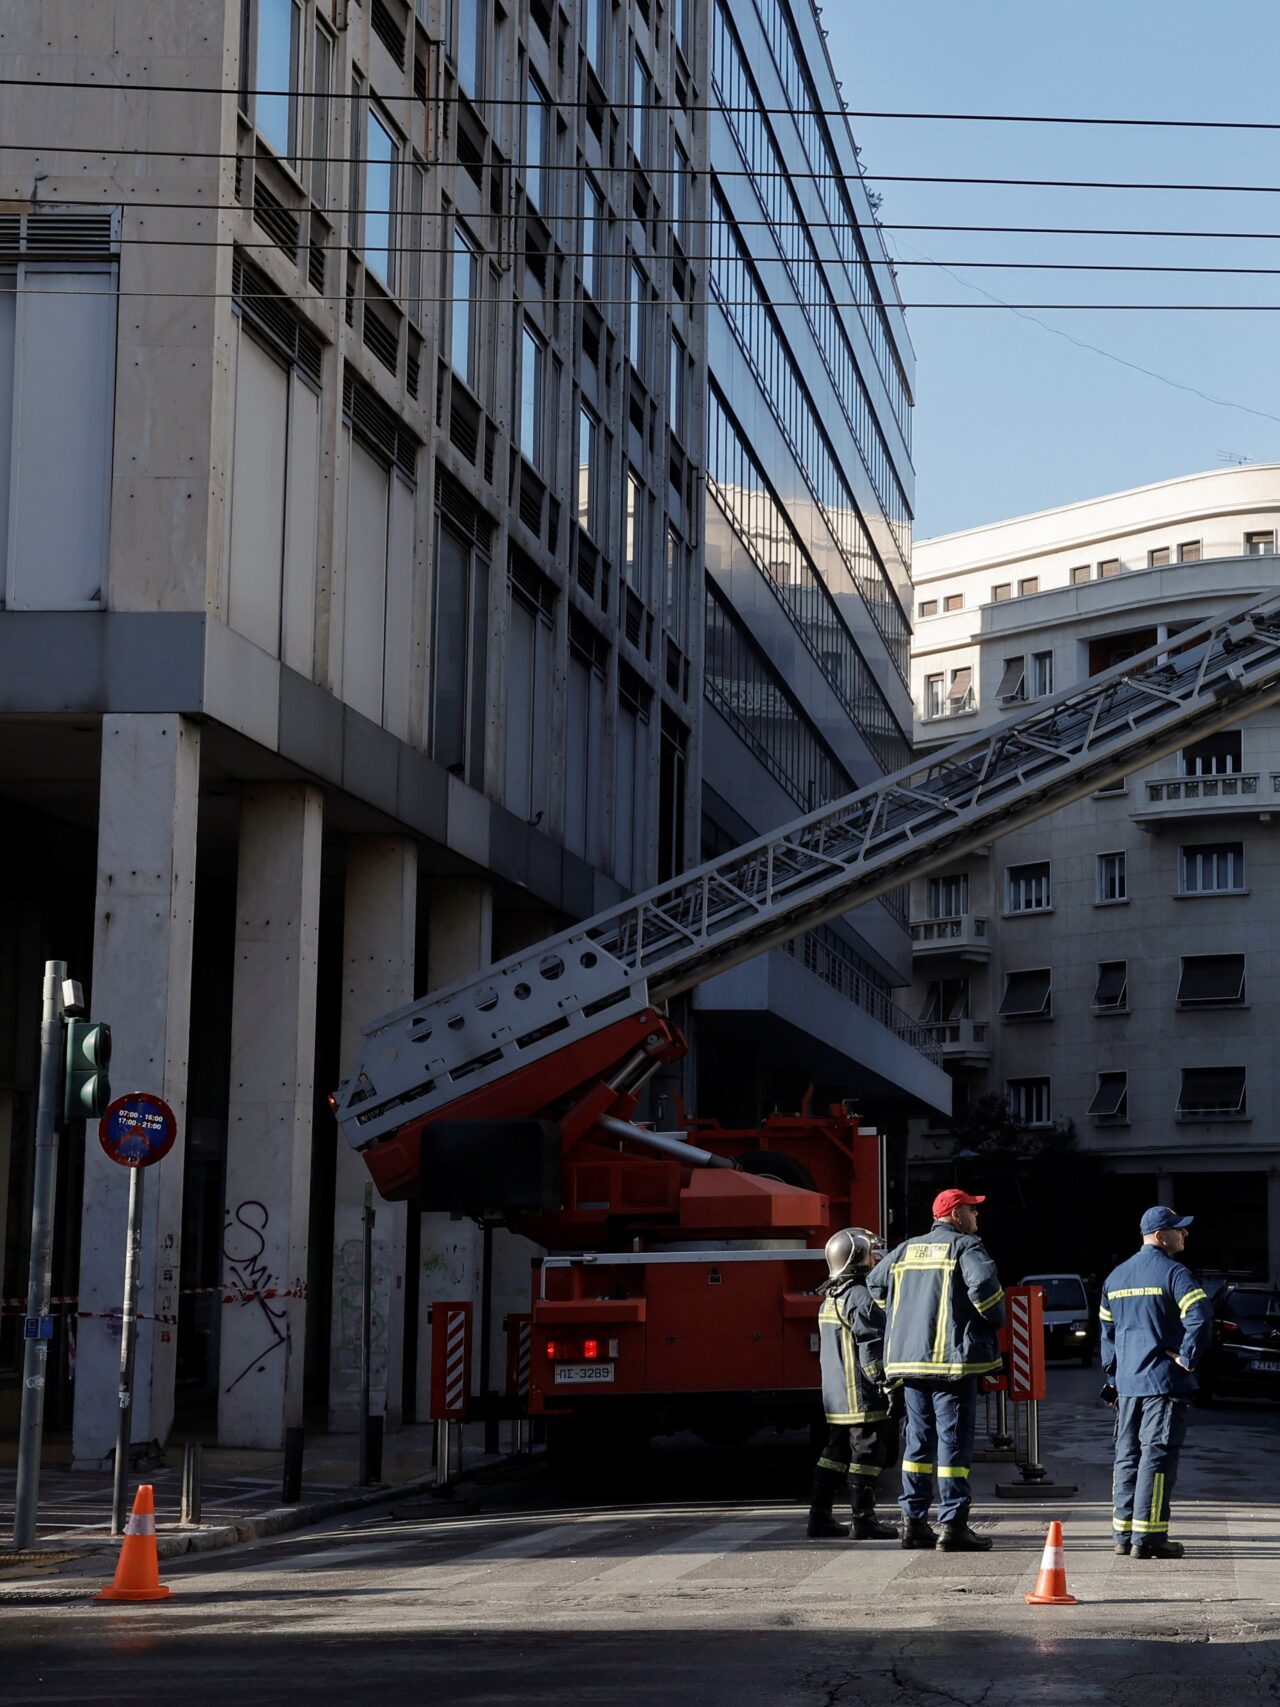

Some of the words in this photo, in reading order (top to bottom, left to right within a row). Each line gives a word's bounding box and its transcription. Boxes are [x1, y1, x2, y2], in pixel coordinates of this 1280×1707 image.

[118, 1109, 139, 1119] 07:00
[118, 1117, 137, 1126] 17:00
[142, 1121, 162, 1130] 21:00
